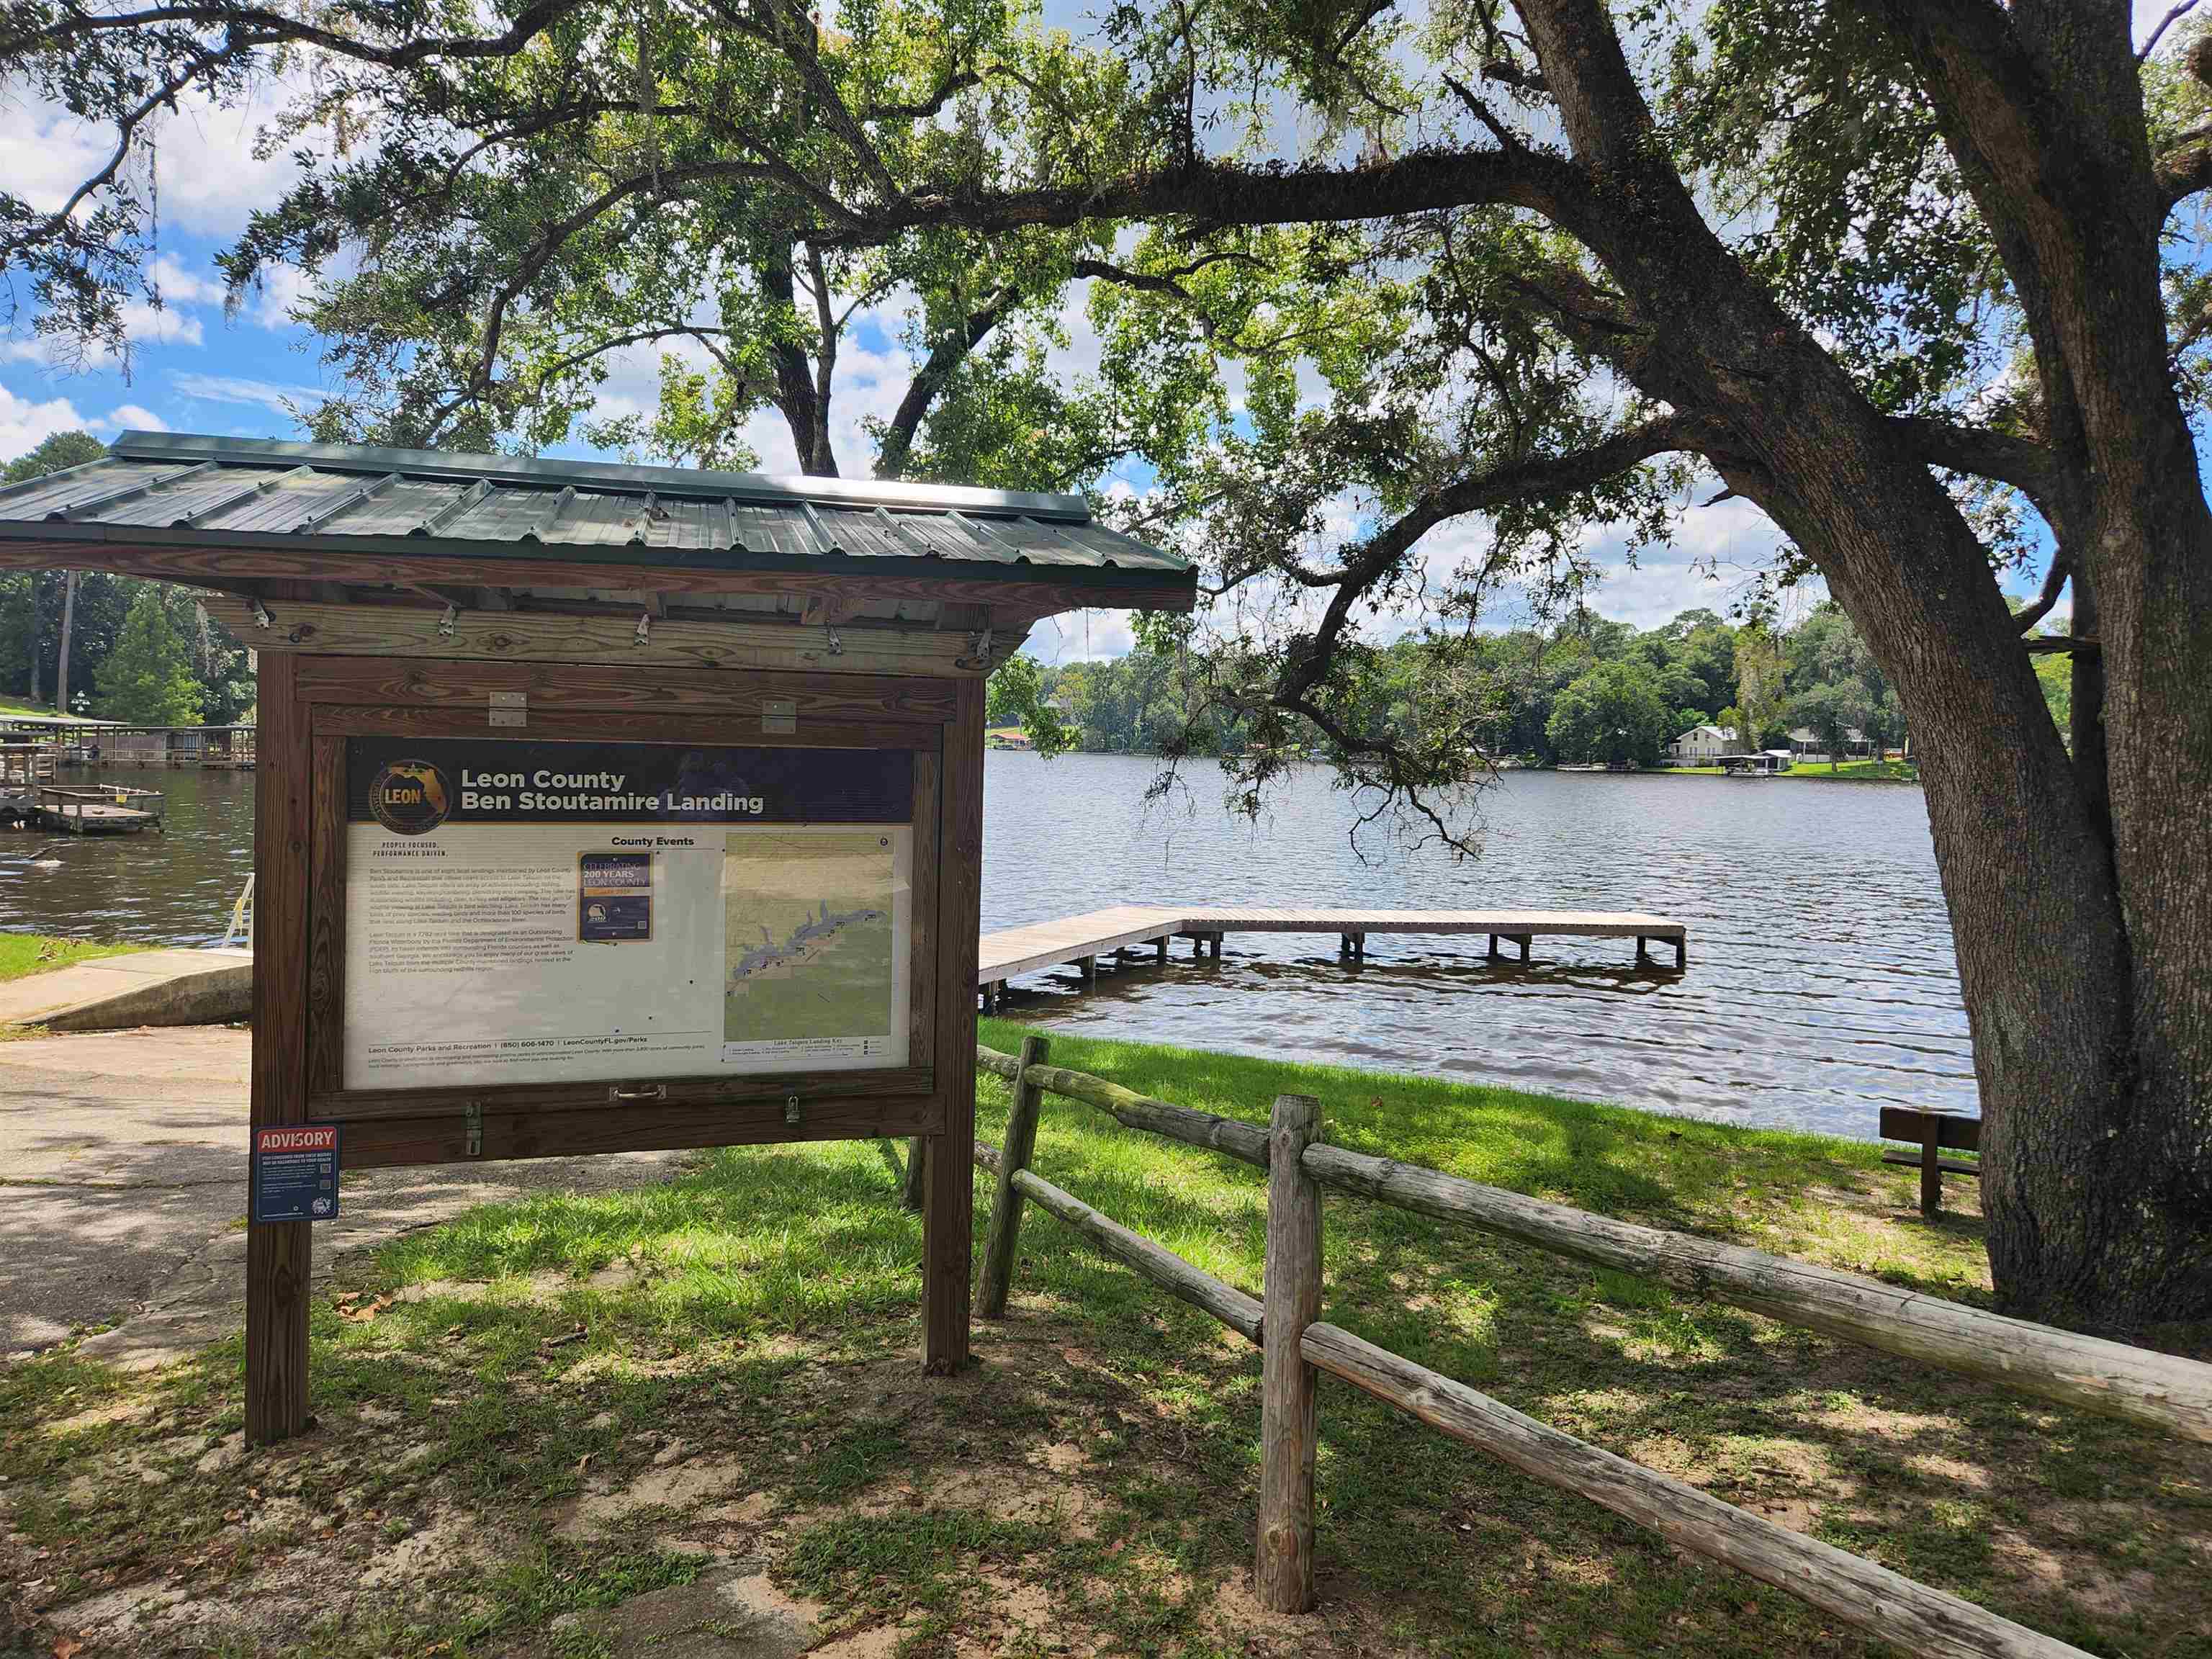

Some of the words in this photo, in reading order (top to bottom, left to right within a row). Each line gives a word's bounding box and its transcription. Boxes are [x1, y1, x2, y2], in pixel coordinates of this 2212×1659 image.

[462, 770, 524, 788] Leon
[534, 770, 626, 792] County
[385, 788, 421, 804] LEON
[462, 791, 511, 810] Ben
[518, 792, 660, 811] Stoutamire
[667, 793, 764, 814] Landing
[611, 836, 654, 848] County
[656, 836, 695, 845] Events
[610, 878, 646, 886] COUNTY
[261, 1130, 333, 1148] ADVISORY
